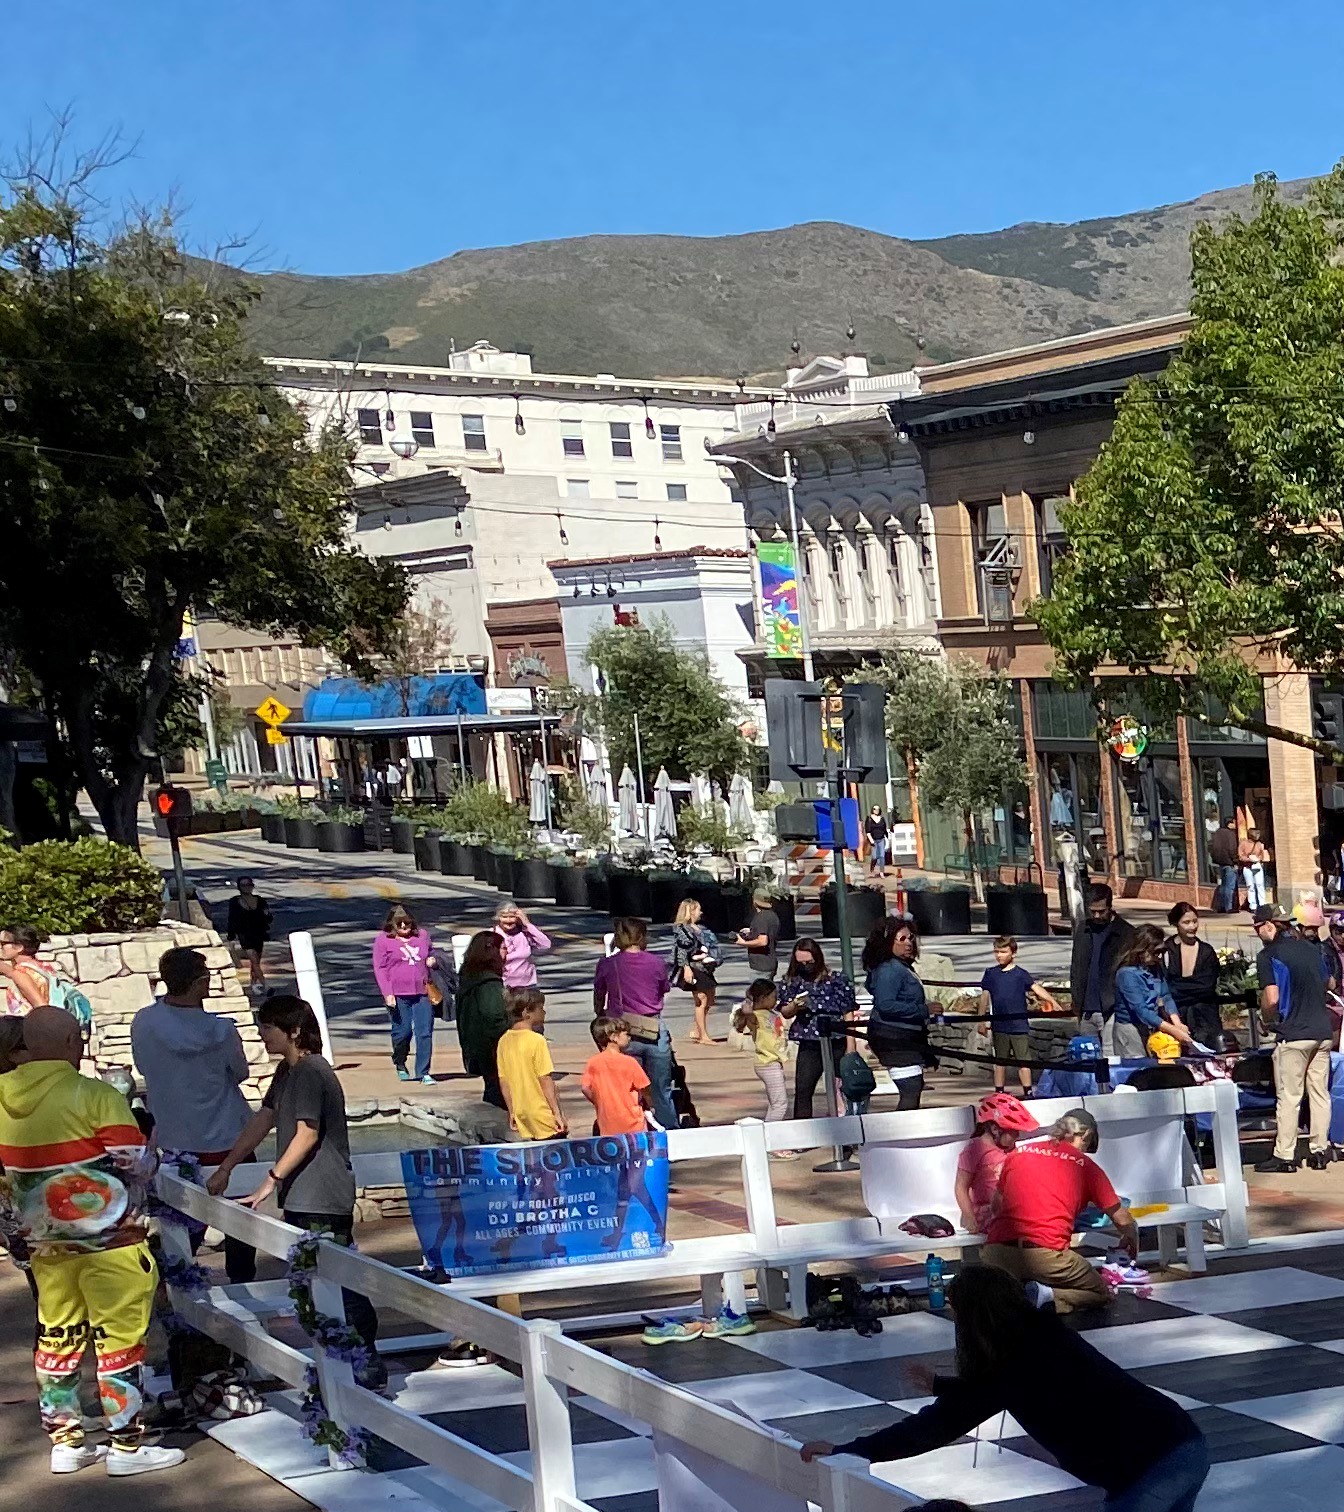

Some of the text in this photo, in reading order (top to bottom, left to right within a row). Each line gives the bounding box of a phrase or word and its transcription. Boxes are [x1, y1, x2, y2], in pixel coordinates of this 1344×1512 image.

[411, 1133, 662, 1175] THE SLOROLL
[423, 1159, 655, 1187] Community Initiative
[488, 1191, 596, 1211] POP UP ROLLER DISCO
[488, 1204, 599, 1225] DJ BROTHA C
[475, 1229, 493, 1240] ALL
[525, 1220, 586, 1237] COMMUNITY
[587, 1216, 620, 1230] EVENT
